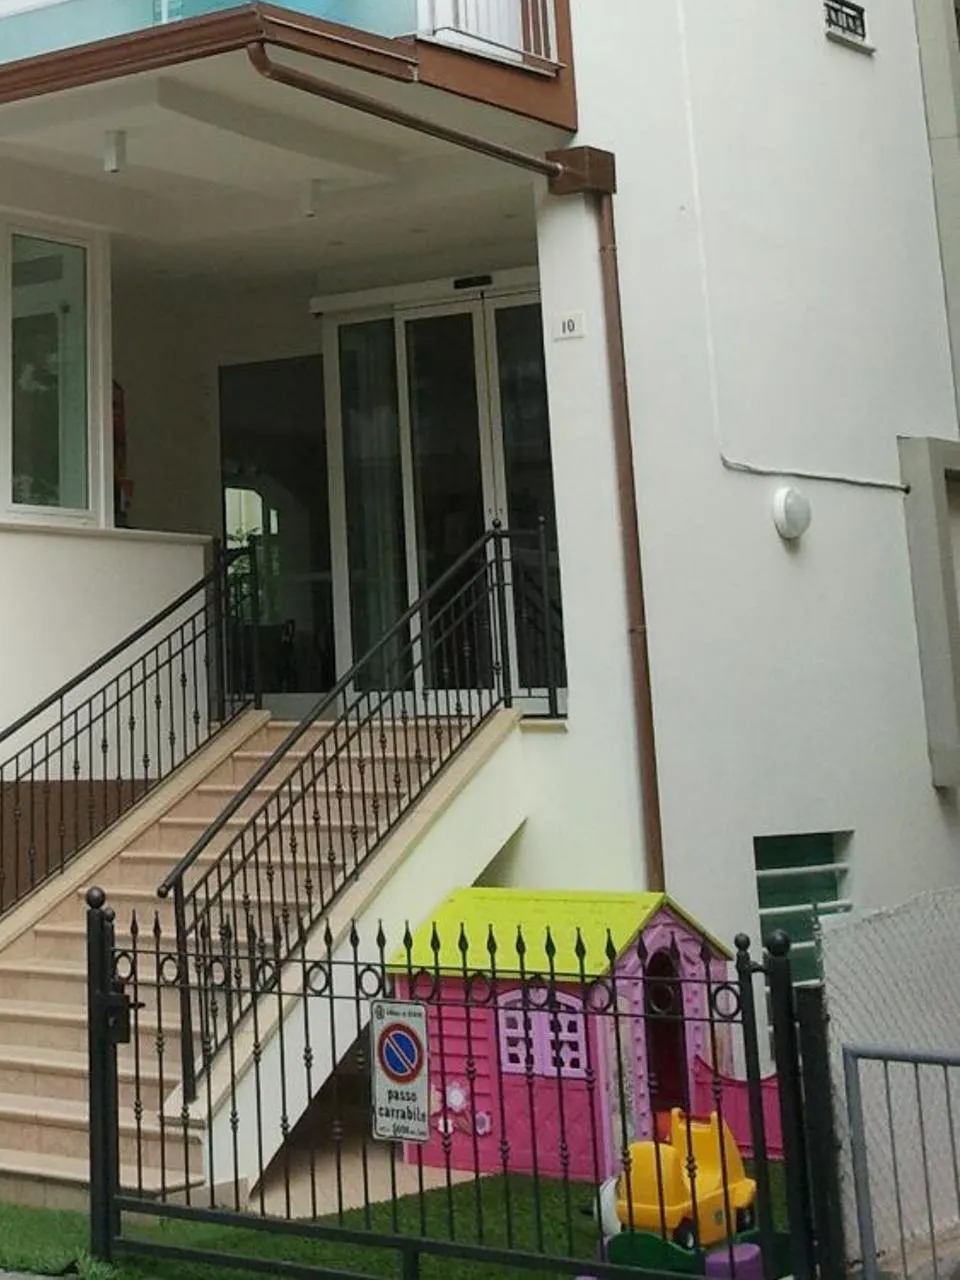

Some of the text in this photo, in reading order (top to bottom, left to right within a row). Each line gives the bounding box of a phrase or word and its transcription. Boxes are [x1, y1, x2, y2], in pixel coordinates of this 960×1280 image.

[561, 318, 575, 334] 10
[387, 1089, 417, 1104] passo
[378, 1106, 426, 1122] carrabile
